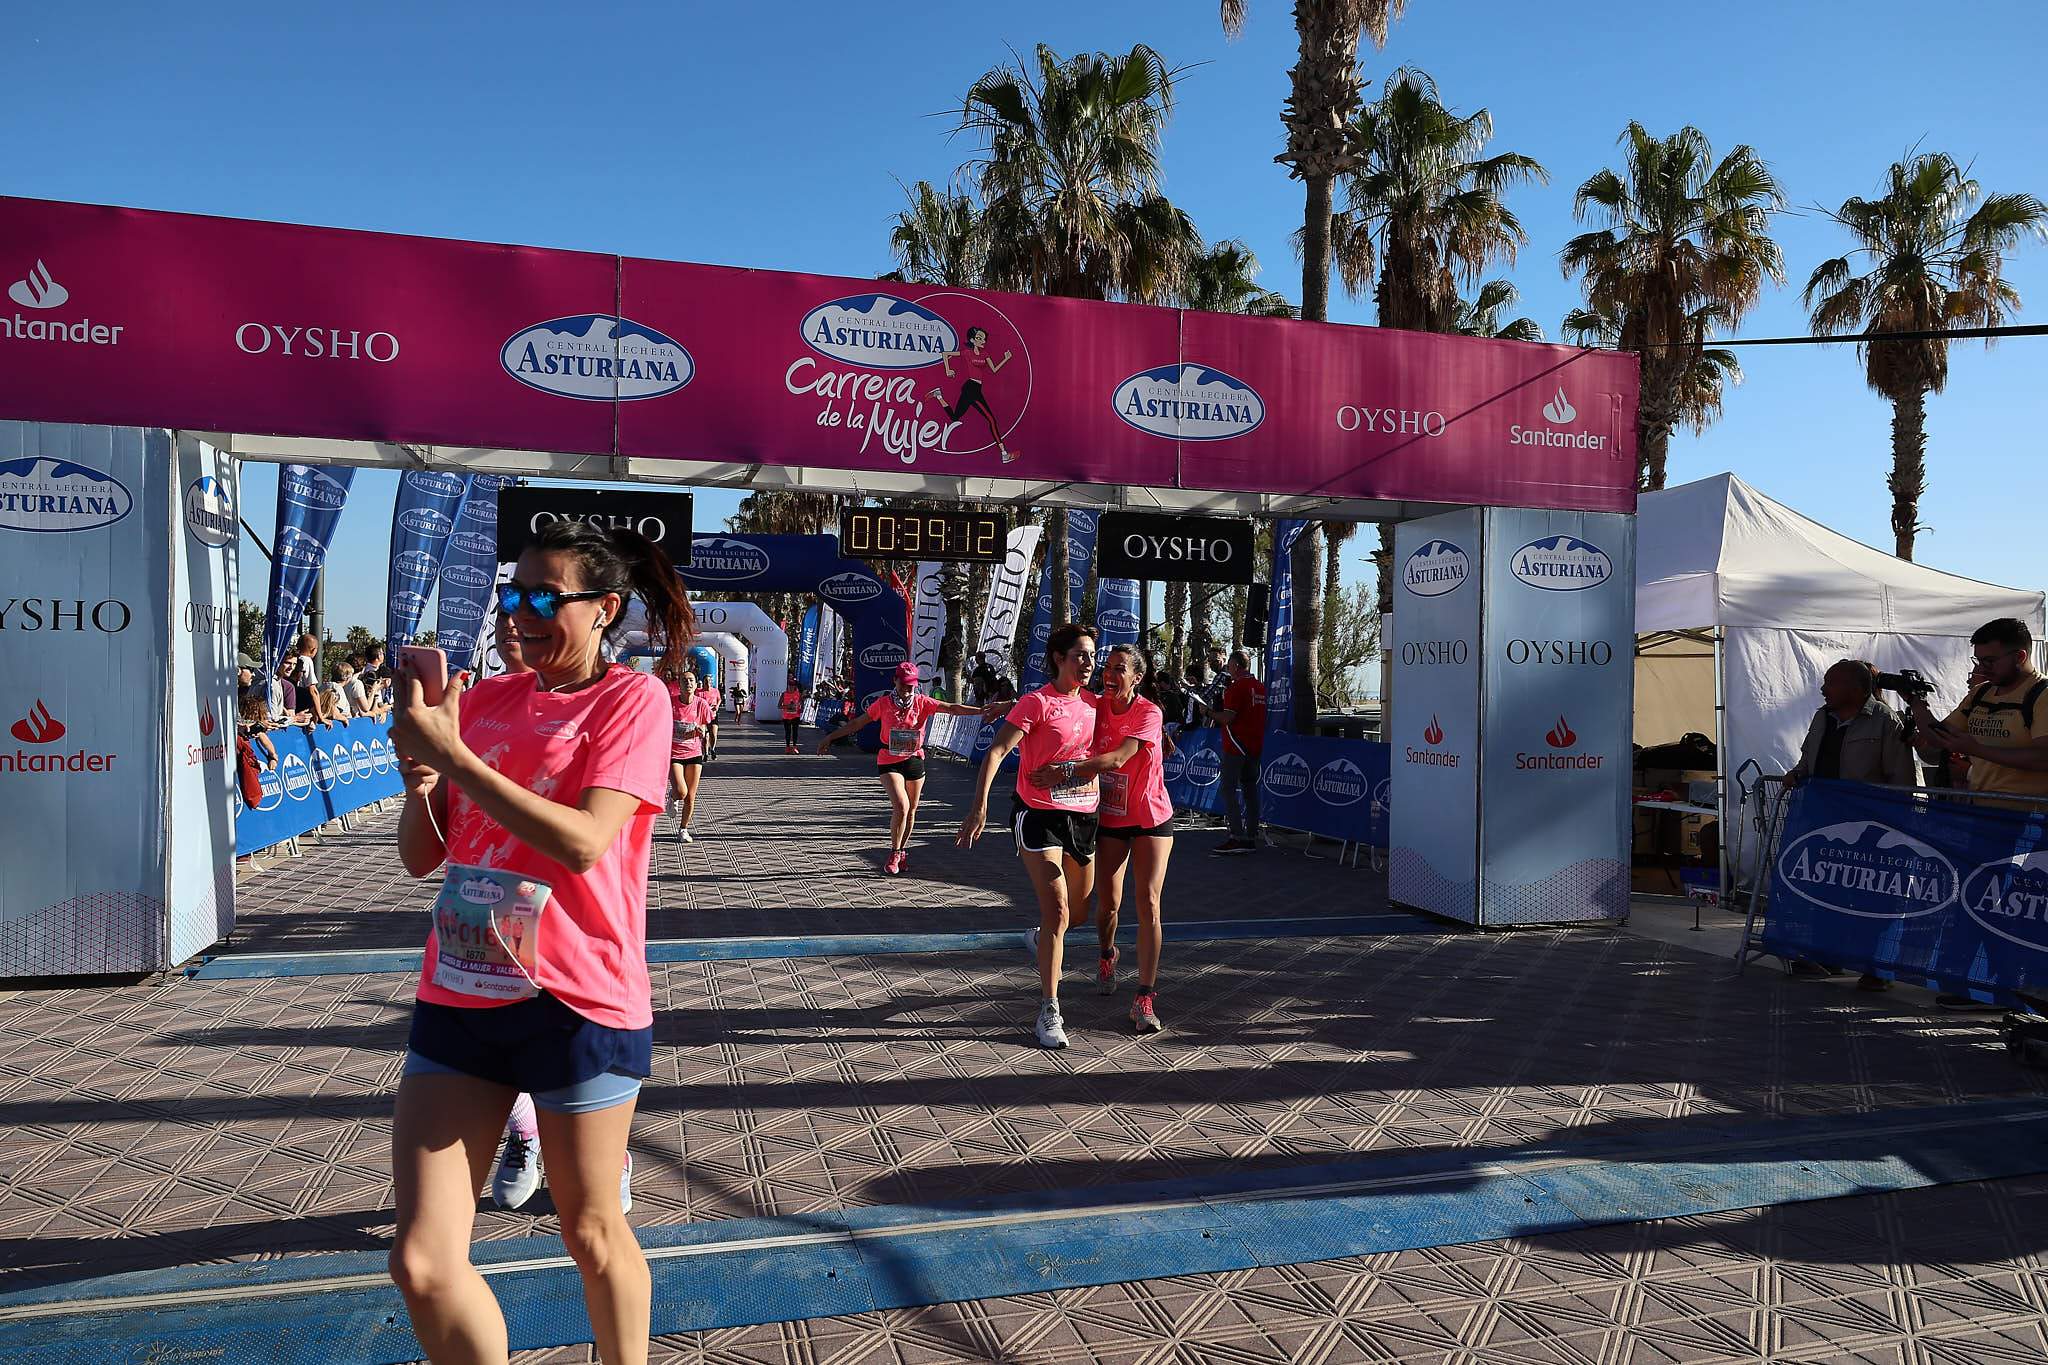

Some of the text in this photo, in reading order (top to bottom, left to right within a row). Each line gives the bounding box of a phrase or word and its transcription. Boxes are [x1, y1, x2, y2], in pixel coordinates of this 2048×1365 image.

[813, 316, 945, 353] ASTURIANA
[838, 316, 943, 332] CENTRAL LECHERA
[236, 322, 399, 362] OYSHO
[547, 341, 607, 353] CENTRAL
[516, 341, 680, 381] ASTURIANA
[785, 357, 917, 403] Carrera
[1125, 387, 1253, 424] ASTURIANA
[1201, 391, 1250, 402] LECHERA
[817, 401, 963, 464] de la Mujer
[1336, 405, 1446, 437] OYSHO
[1510, 425, 1607, 450] Santander
[56, 483, 115, 493] LECHERA
[411, 474, 461, 495] ASTURIANA
[452, 536, 495, 553] ASTURIANA
[852, 516, 995, 554] 00:39:12
[1123, 534, 1233, 562] OYSHO
[1533, 553, 1566, 561] CENTRAL
[445, 570, 488, 585] ASTURIANA
[1407, 564, 1465, 585] ASTURIANA
[1517, 554, 1605, 578] ASTURIANA
[824, 581, 878, 594] ASTURIANA
[185, 601, 232, 637] OYSHO
[440, 603, 481, 617] ASTURIANA
[1402, 639, 1468, 666] OYSHO
[1506, 639, 1612, 666] OYSHO
[1406, 746, 1460, 769] Santander
[1515, 752, 1604, 770] Santander
[1266, 768, 1306, 788] ASTURIANA
[1317, 774, 1361, 797] ASTURIANA
[1819, 847, 1940, 873] CENTRAL LECHERA
[1788, 847, 1941, 903] ASTURIANA
[469, 962, 492, 973] MUJER
[483, 981, 521, 993] Santander
